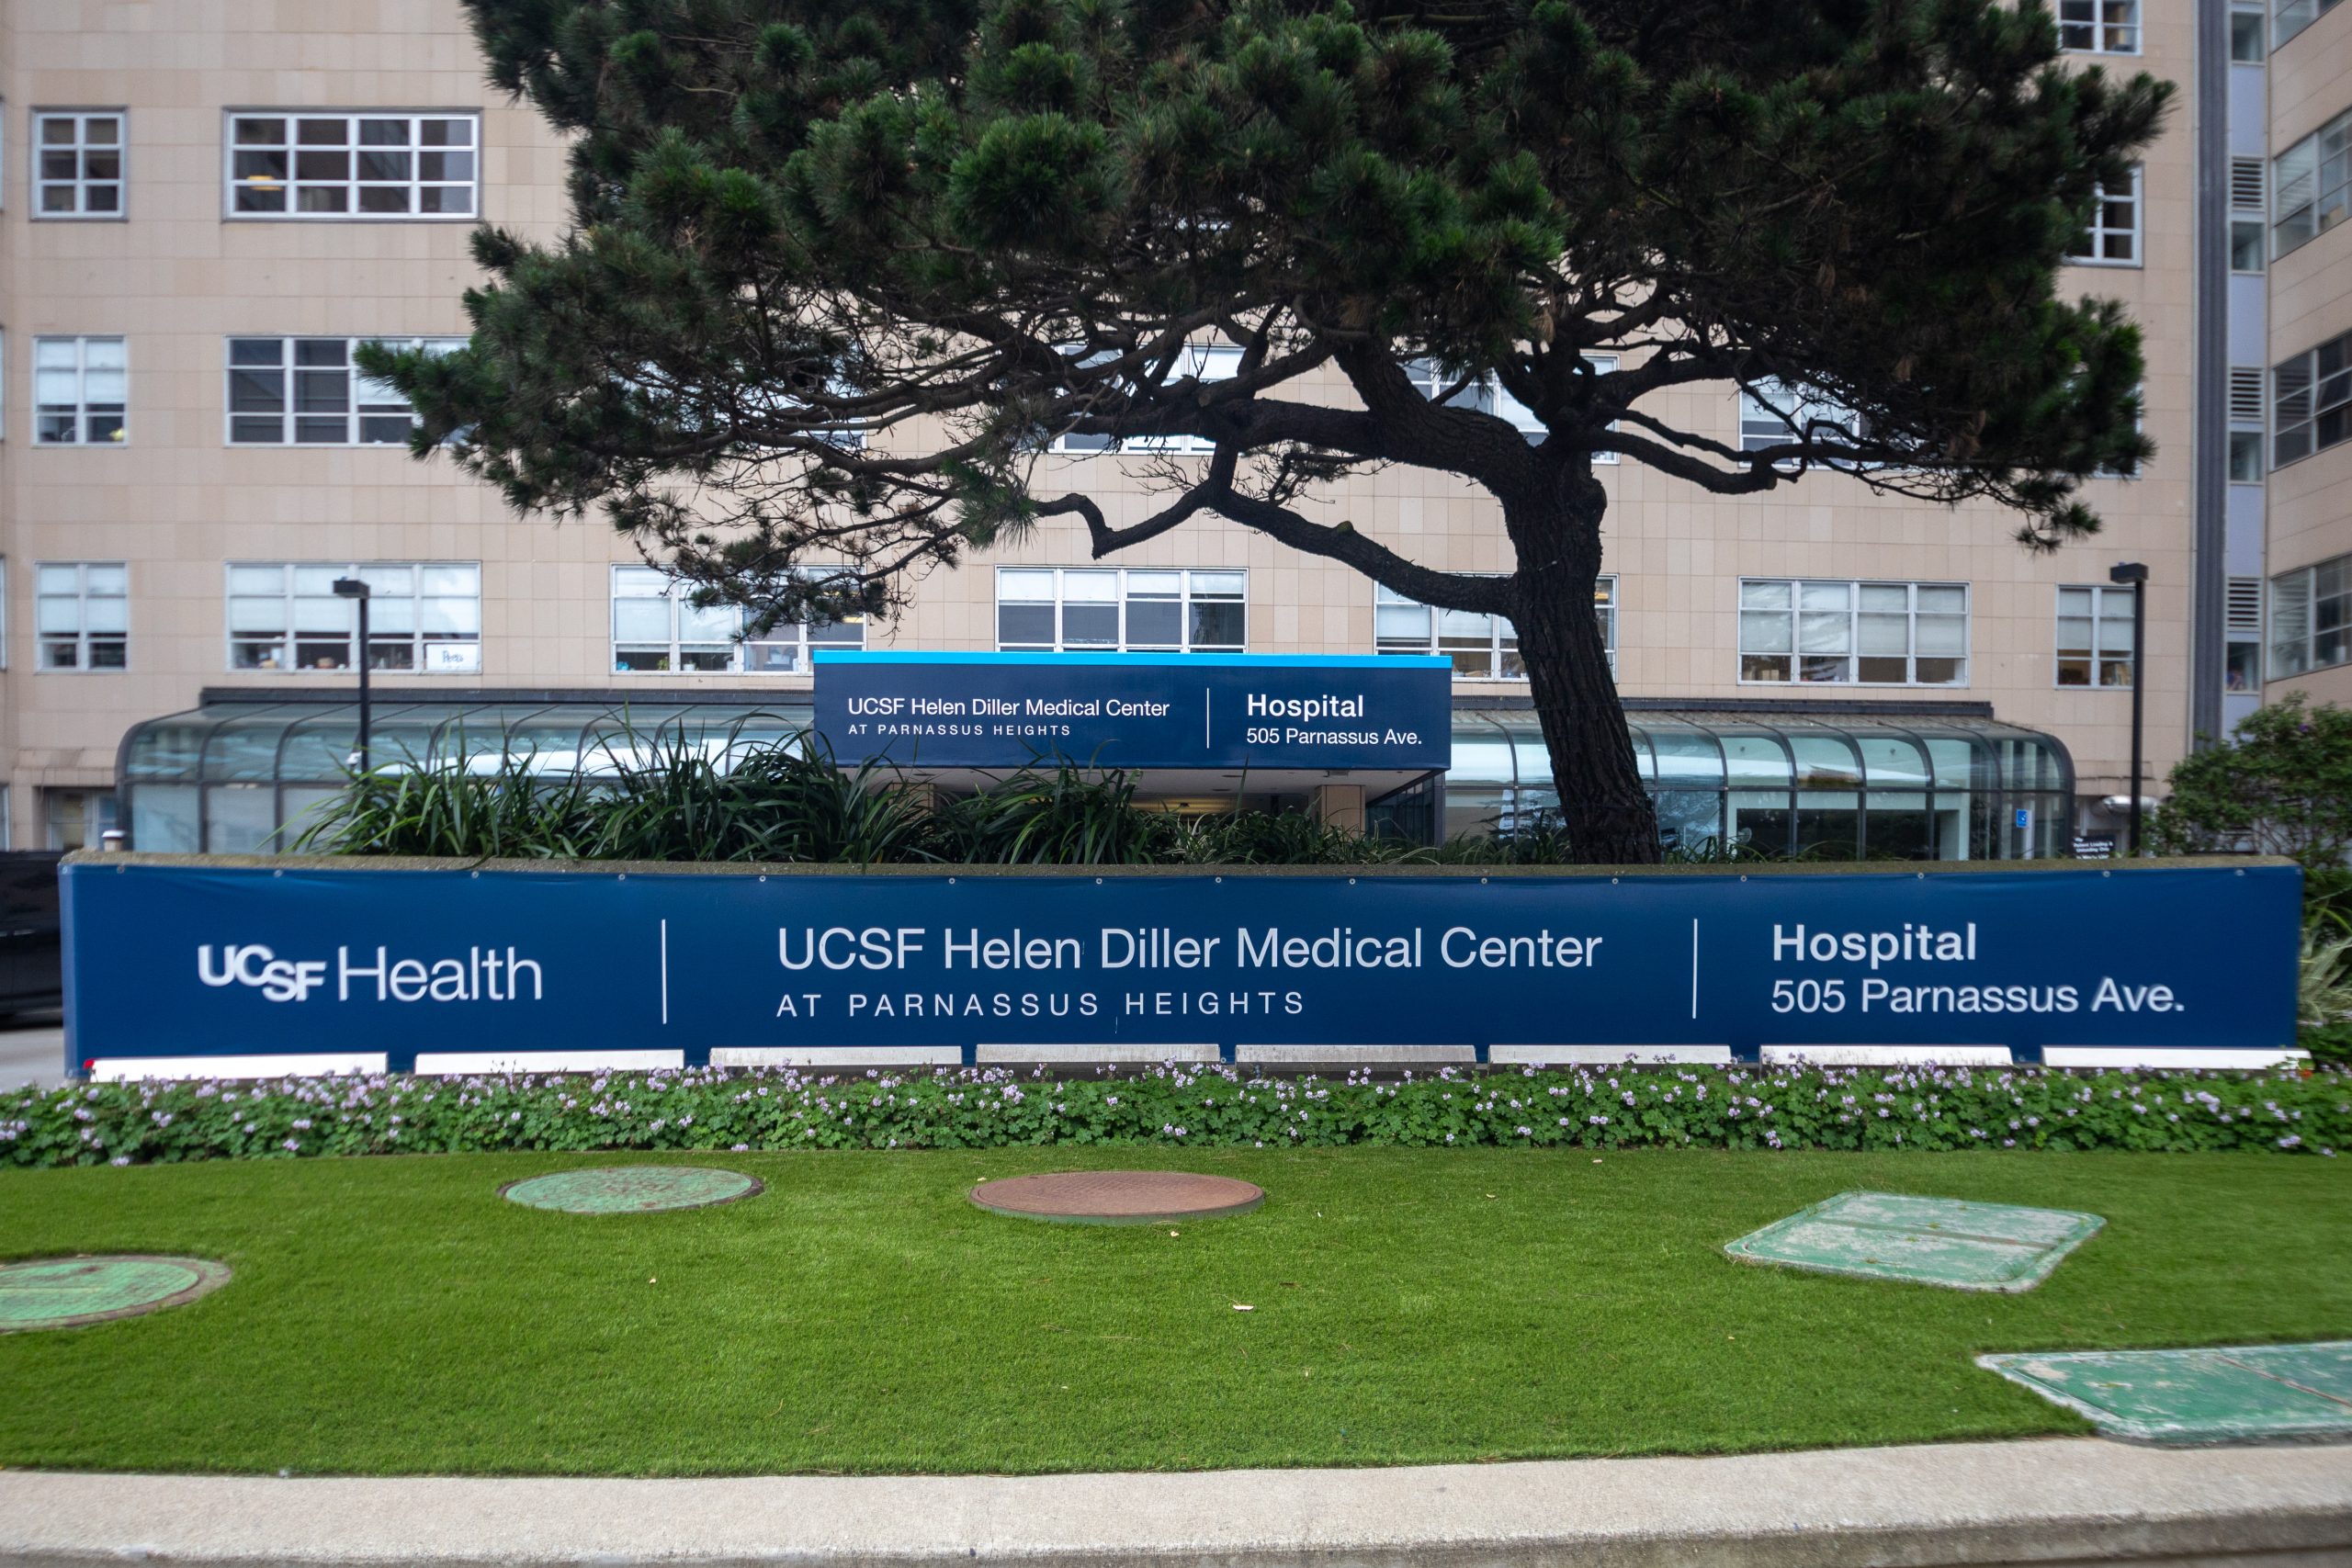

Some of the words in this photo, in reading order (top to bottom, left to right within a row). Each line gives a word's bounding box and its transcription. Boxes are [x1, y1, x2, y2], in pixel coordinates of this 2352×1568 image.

[848, 697, 906, 716] UCSF
[910, 697, 966, 716] Helen
[972, 698, 1021, 716] Diller
[1025, 698, 1100, 716] Medical
[1105, 698, 1170, 716] Center
[1248, 694, 1363, 723] Hospital
[847, 724, 868, 735] AT
[877, 724, 983, 736] PARNASSUS
[993, 725, 1070, 736] HEIGHTS
[1246, 728, 1280, 744] 505
[1286, 728, 1379, 745] Parnassus
[1383, 728, 1422, 745] Ave.
[779, 927, 925, 970] UCSF
[944, 928, 1080, 970] Helen
[1102, 928, 1220, 969] Diller
[1238, 927, 1421, 968] Medical
[1441, 926, 1603, 968] Center
[1773, 922, 1976, 969] Hospital
[198, 944, 326, 1002] UCSF
[338, 946, 542, 1001] Health
[776, 994, 821, 1018] AT
[849, 992, 1098, 1017] PARNASSUS
[1125, 991, 1303, 1015] HEIGHTS
[1771, 979, 1846, 1013] 505
[1861, 978, 2078, 1013] Parnassus
[2091, 977, 2184, 1012] Ave.
